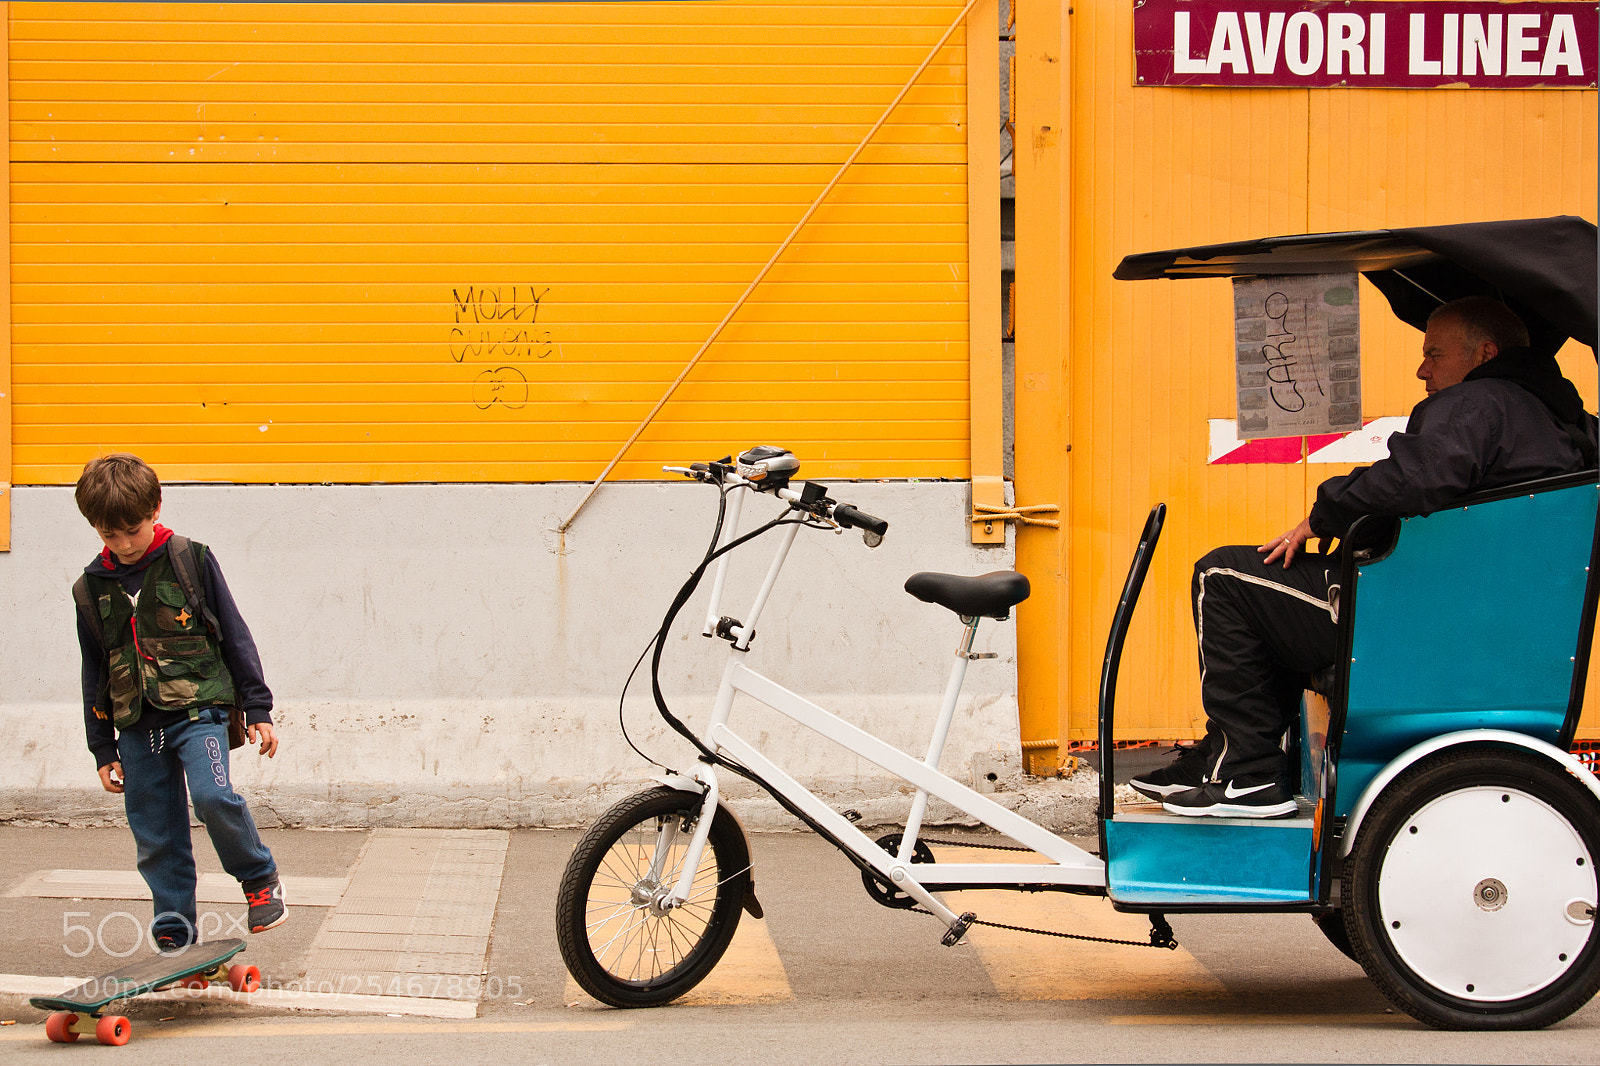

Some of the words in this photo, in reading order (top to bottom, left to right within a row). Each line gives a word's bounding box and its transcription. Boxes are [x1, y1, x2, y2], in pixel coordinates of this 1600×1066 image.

[1173, 11, 1387, 76] LAVORI
[1408, 13, 1585, 76] LINEA
[452, 286, 550, 324] MOLLY
[1261, 291, 1305, 413] CARLO
